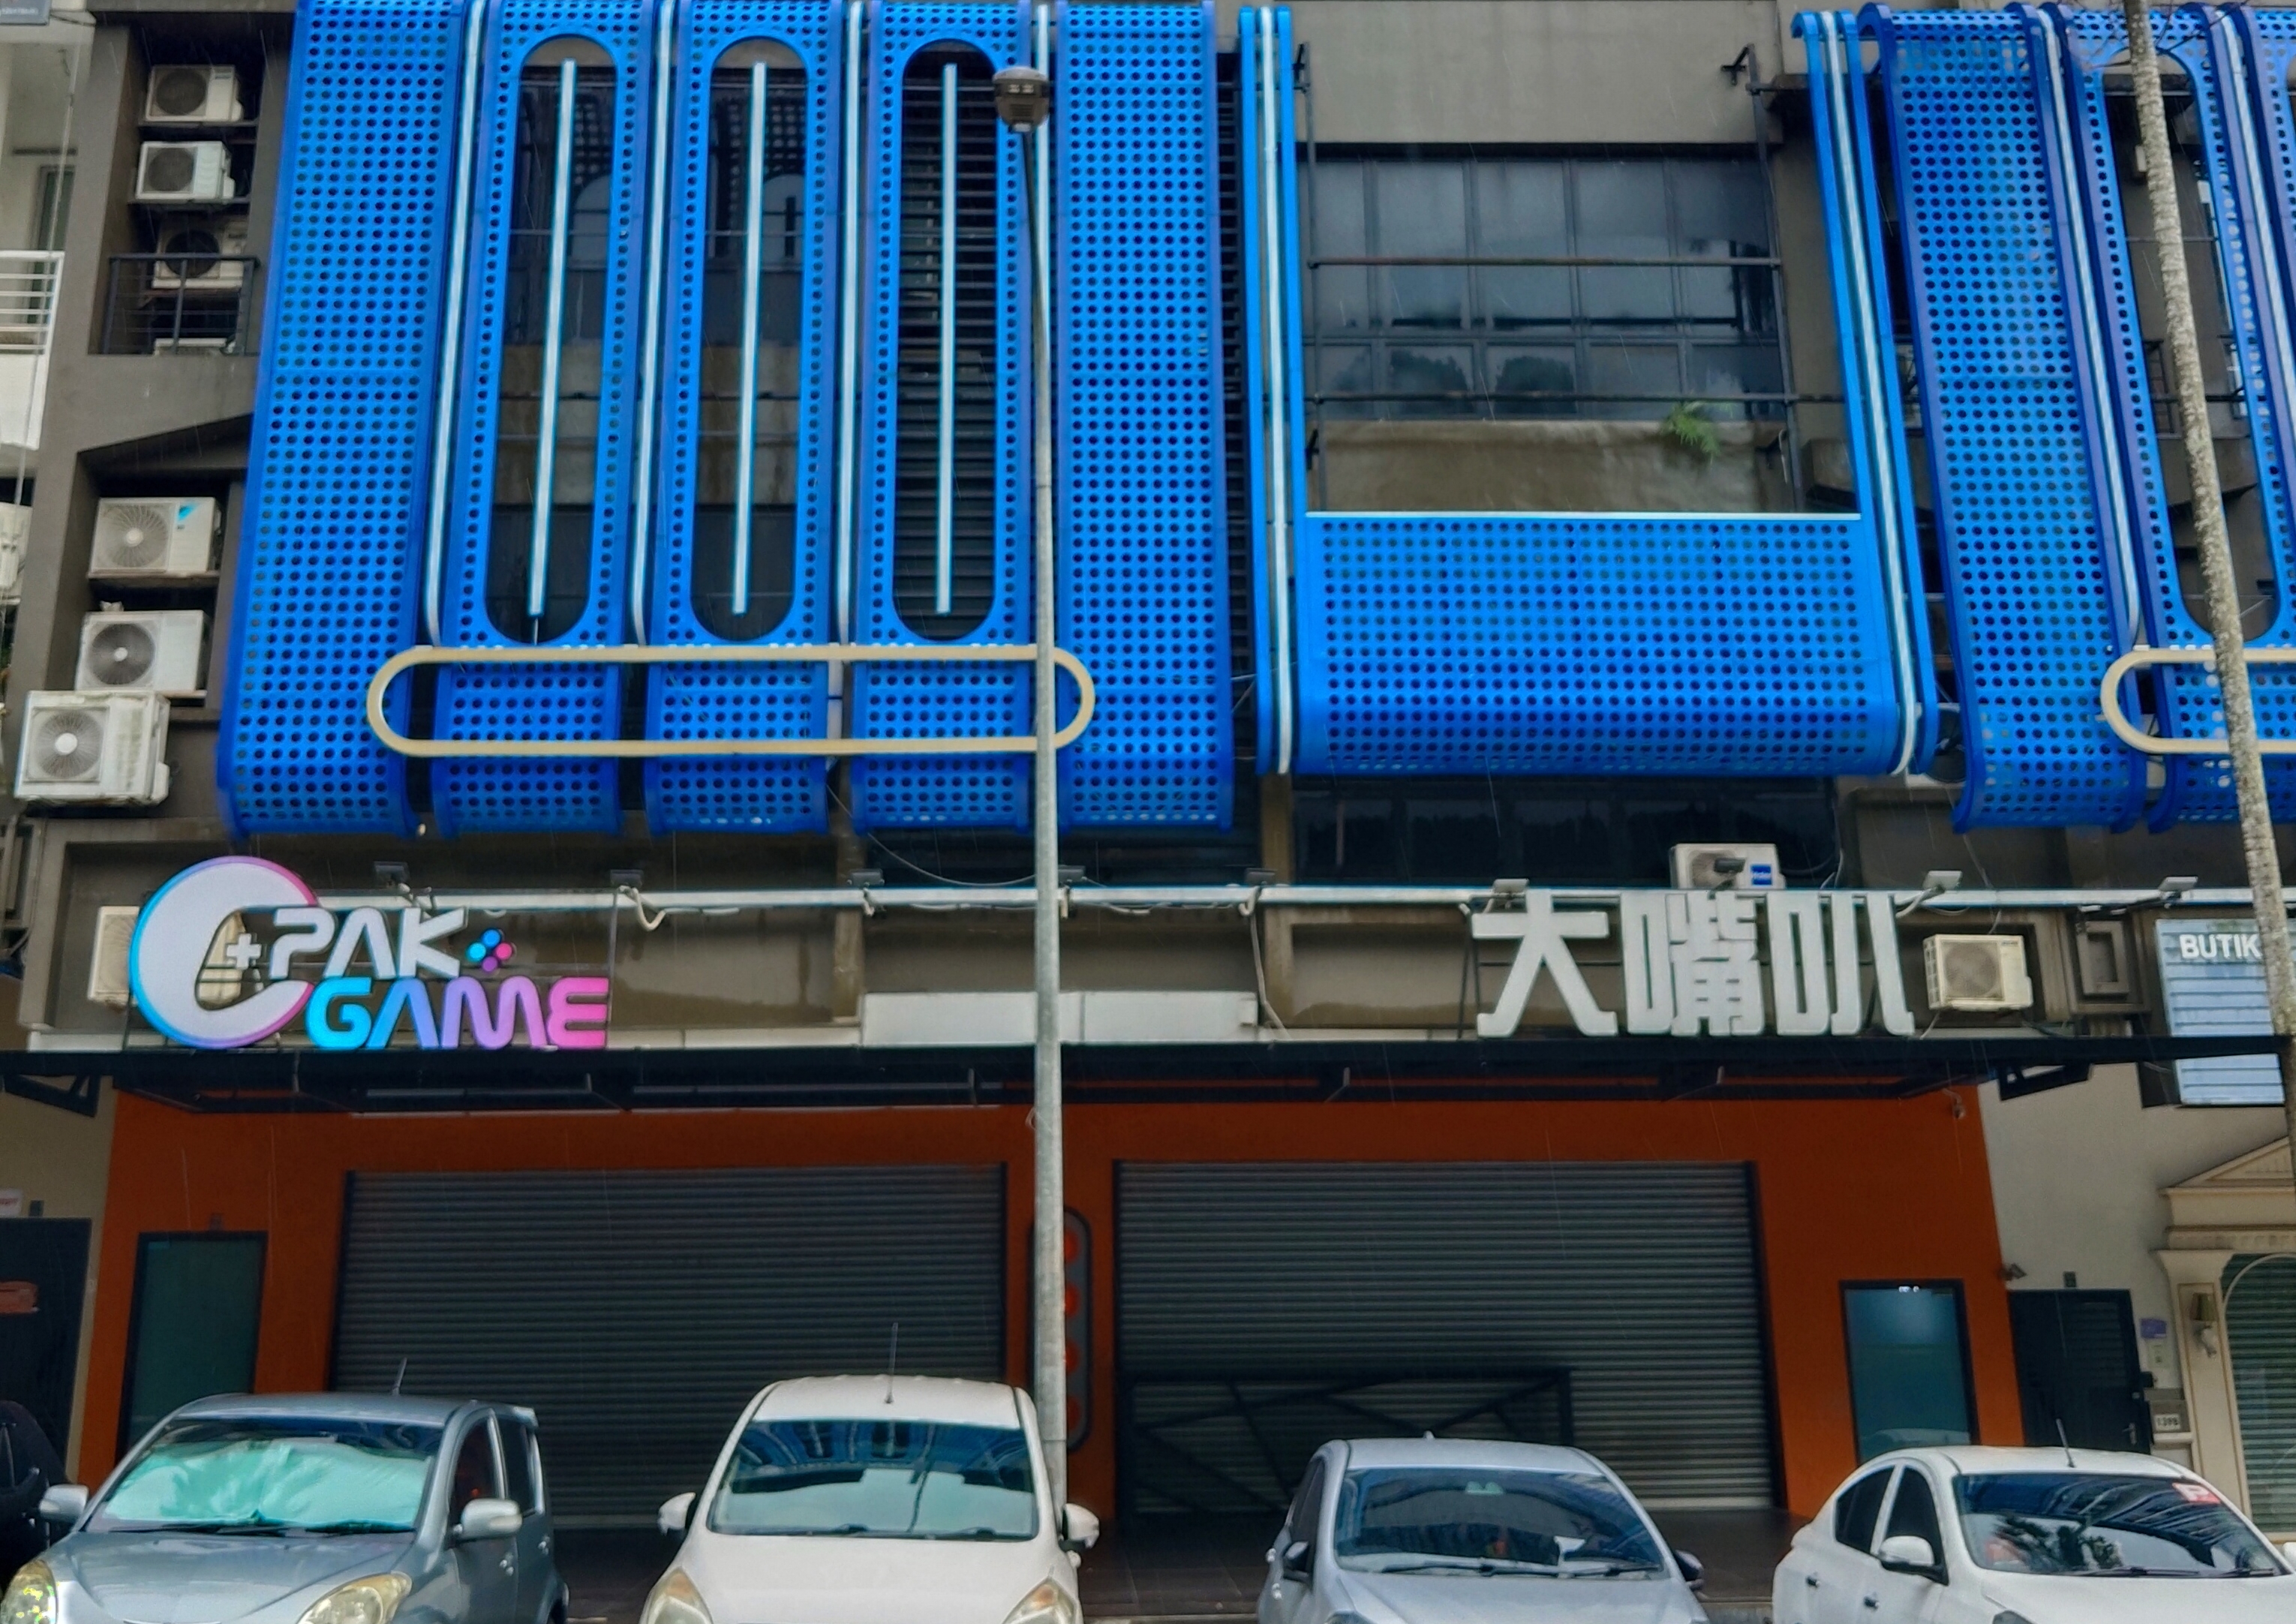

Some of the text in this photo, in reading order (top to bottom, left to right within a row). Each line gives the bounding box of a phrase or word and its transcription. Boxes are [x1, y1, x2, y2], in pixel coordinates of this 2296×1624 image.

[1471, 889, 1915, 1039] 大嘴叭
[2179, 934, 2263, 960] BUTIK
[305, 976, 610, 1050] GAME
